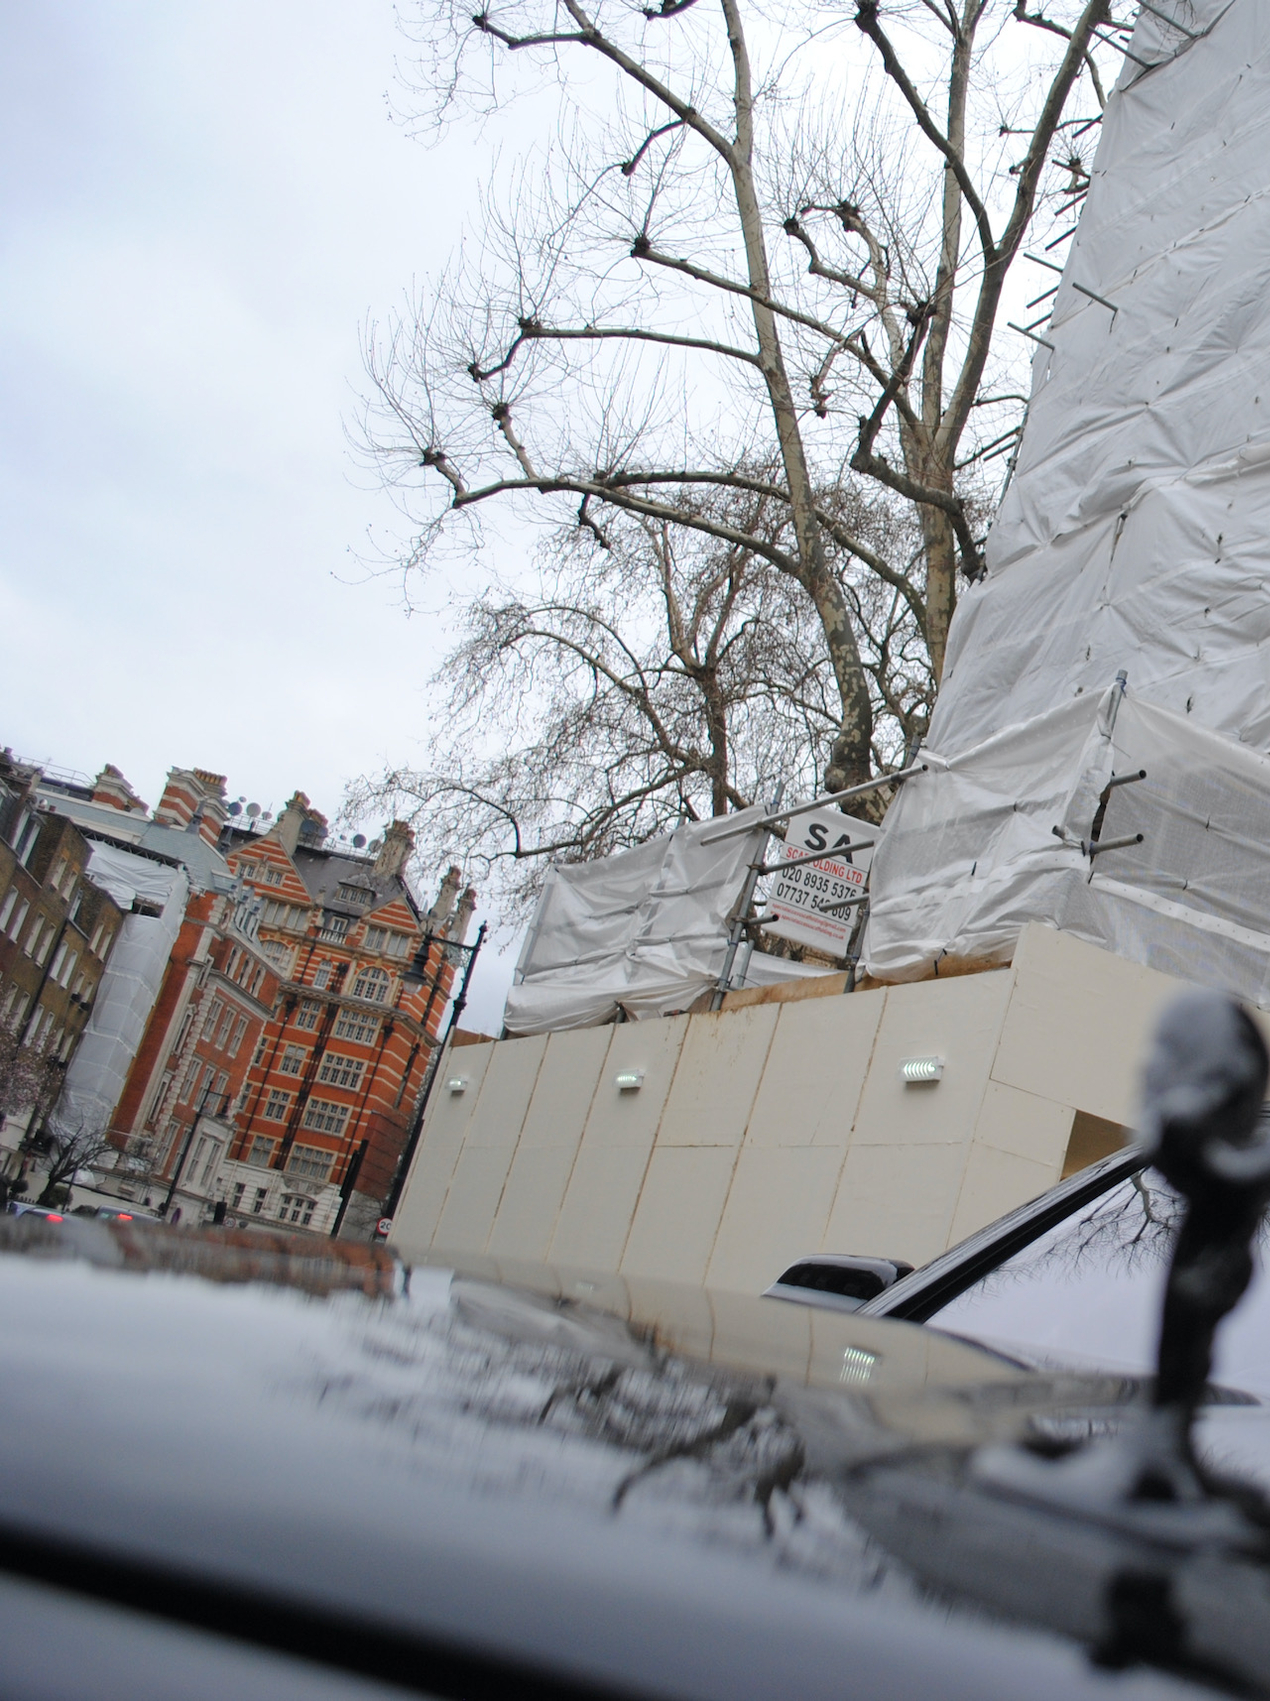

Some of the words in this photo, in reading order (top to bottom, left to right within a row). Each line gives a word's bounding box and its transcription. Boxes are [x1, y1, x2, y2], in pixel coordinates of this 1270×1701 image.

[804, 823, 853, 864] SA
[786, 847, 845, 878] SCAOLDING
[846, 869, 863, 884] LTD
[782, 867, 802, 883] 020
[803, 872, 829, 893] 8935
[776, 882, 810, 906] 07737
[380, 1221, 392, 1231] 20
